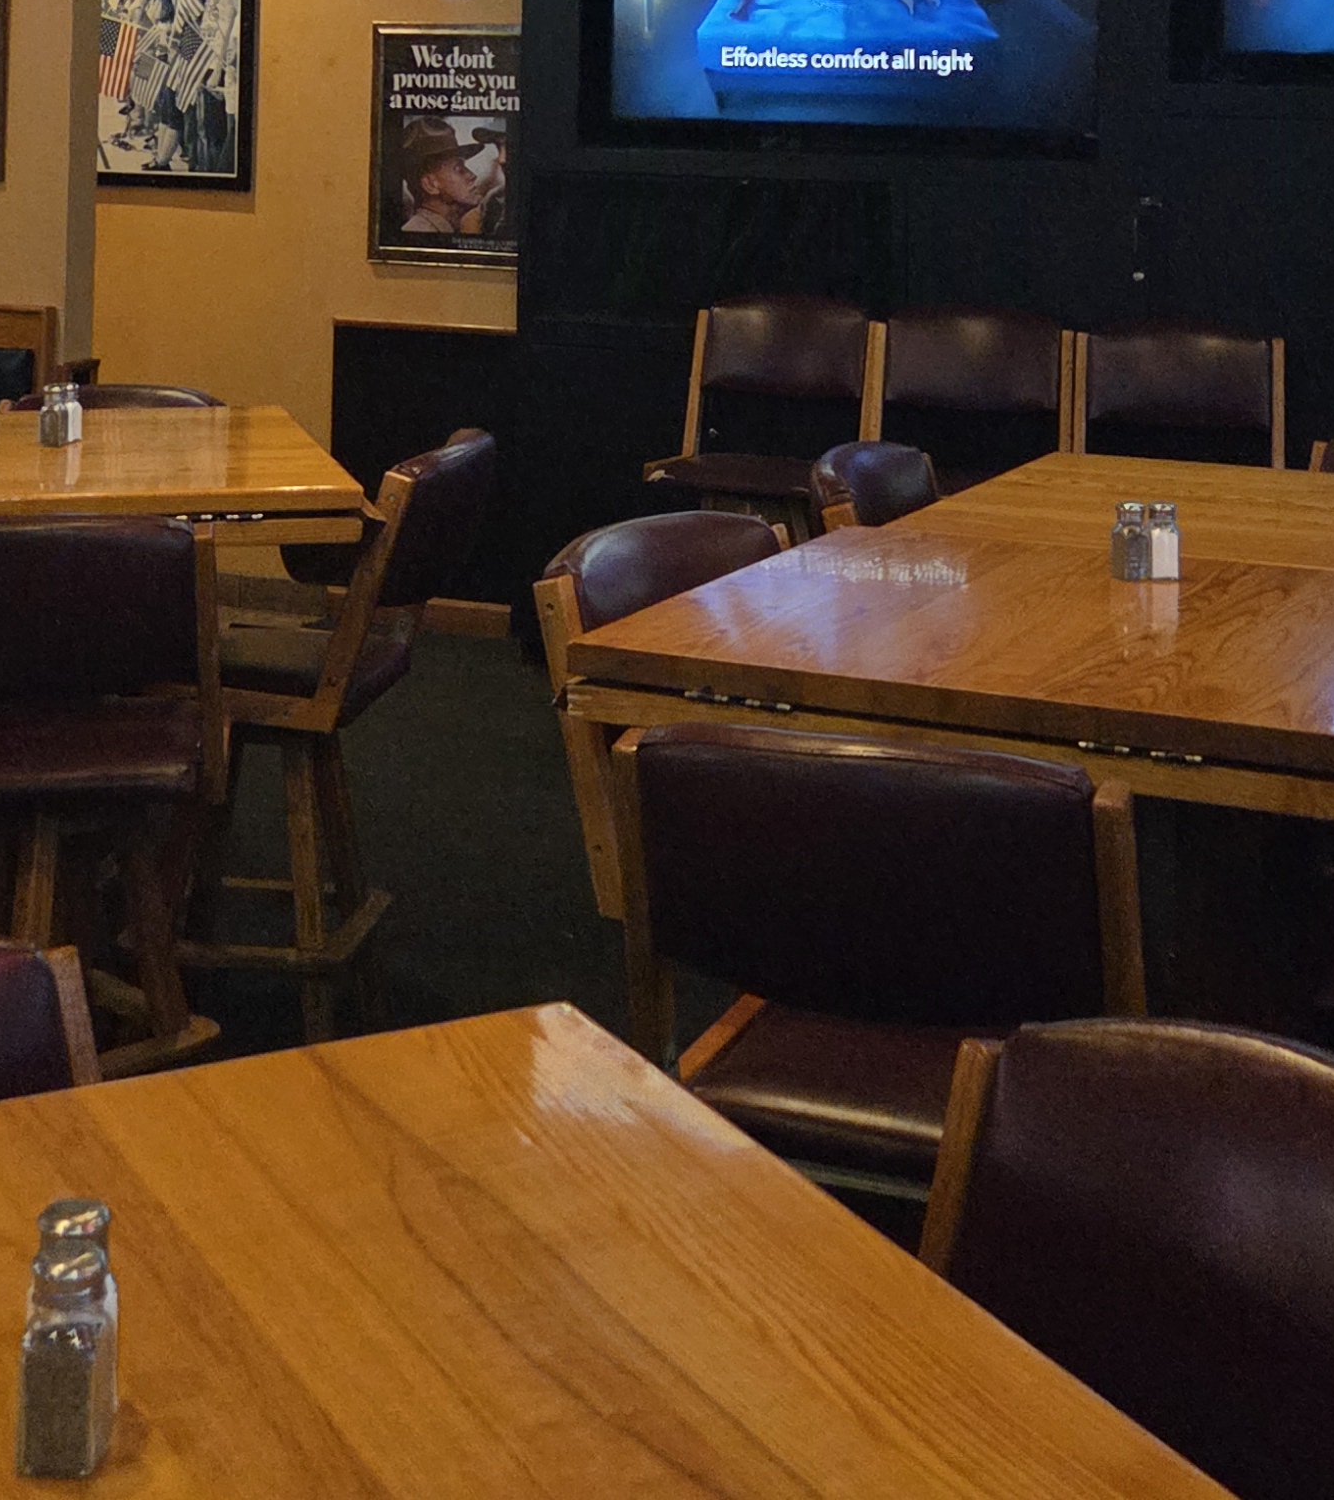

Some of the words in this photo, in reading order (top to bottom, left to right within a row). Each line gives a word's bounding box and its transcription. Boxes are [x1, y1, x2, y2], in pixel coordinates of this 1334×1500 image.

[411, 44, 444, 68] We
[445, 45, 496, 69] don't
[721, 46, 808, 68] Effortless
[811, 47, 889, 69] comfort
[892, 48, 915, 70] all
[919, 49, 974, 76] night
[393, 68, 477, 92] promise
[478, 73, 516, 93] you
[389, 93, 403, 109] a
[405, 93, 449, 110] rose
[450, 90, 521, 112] garden
